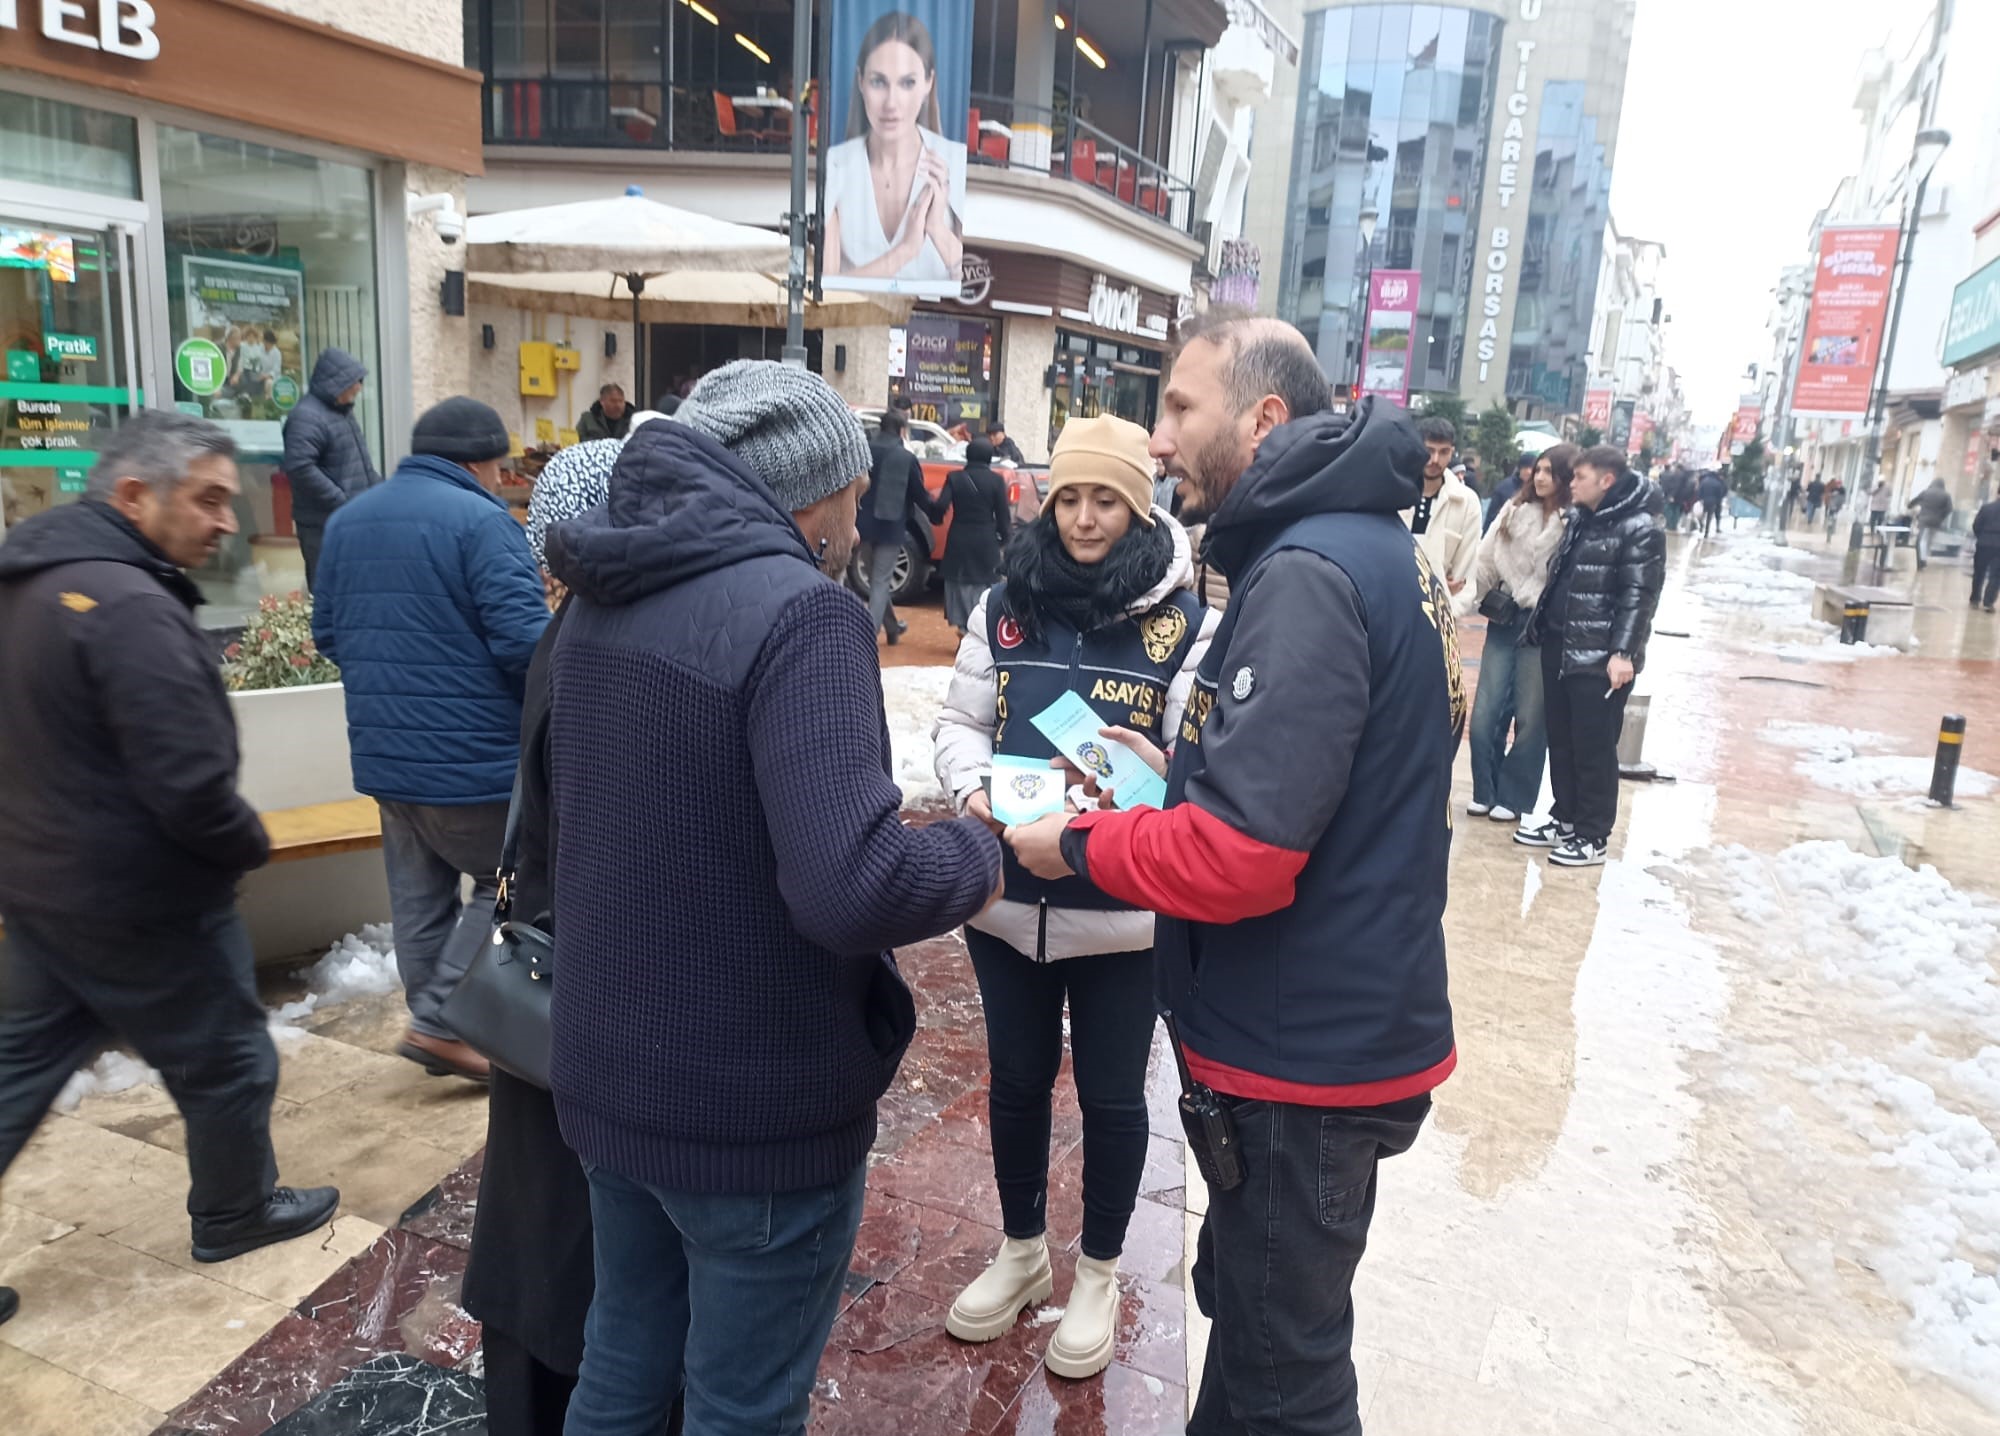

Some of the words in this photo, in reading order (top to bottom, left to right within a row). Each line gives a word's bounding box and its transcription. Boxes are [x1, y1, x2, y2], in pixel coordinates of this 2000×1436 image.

[1497, 40, 1536, 208] TİCARET
[1831, 263, 1886, 277] FIRSAT
[1477, 227, 1509, 382] BORSASI
[47, 336, 92, 354] Pratik
[943, 384, 976, 395] BEDAVA
[17, 400, 61, 414] Burada
[19, 417, 43, 430] tüm
[45, 418, 89, 432] işlemler
[1090, 679, 1153, 713] ASAYİŞ
